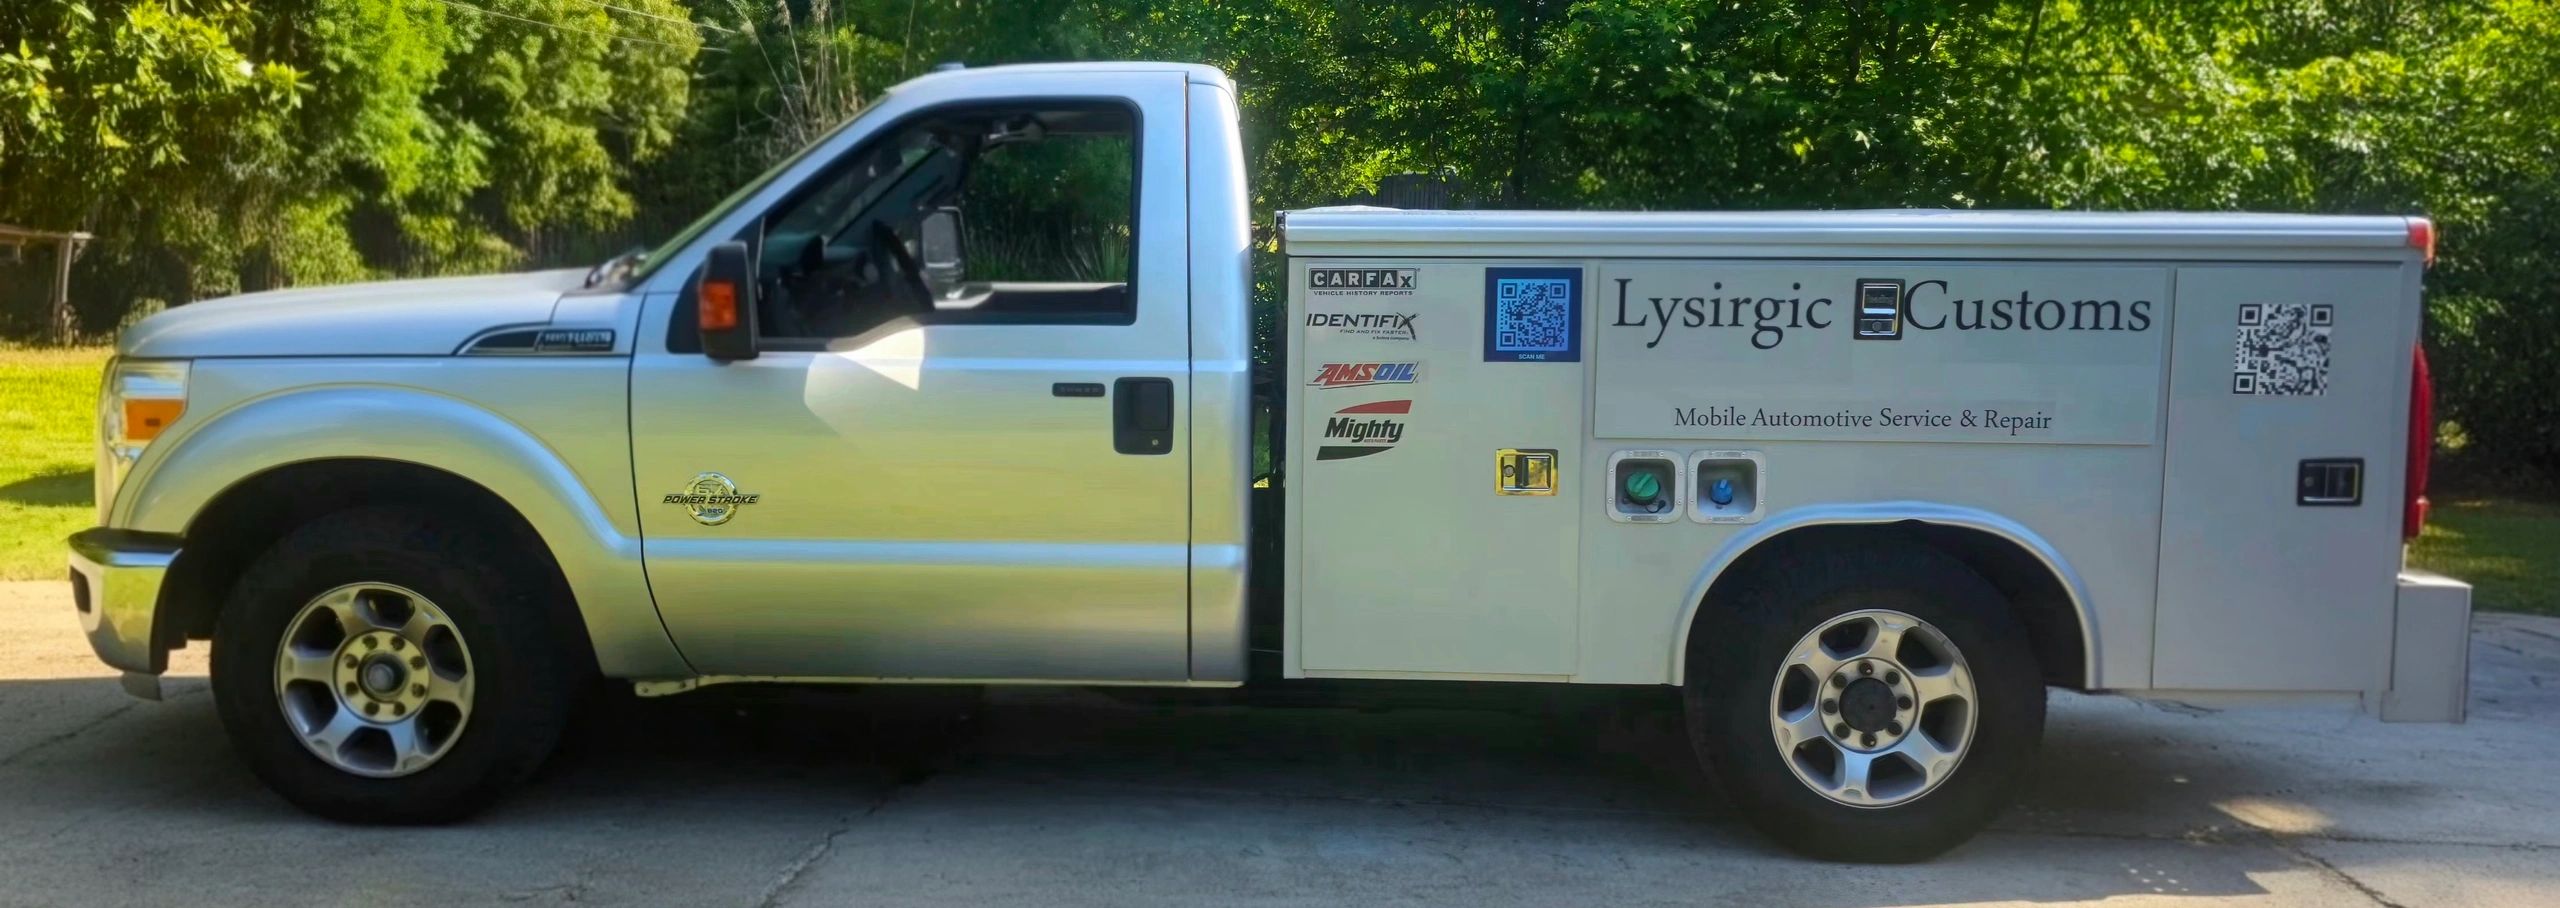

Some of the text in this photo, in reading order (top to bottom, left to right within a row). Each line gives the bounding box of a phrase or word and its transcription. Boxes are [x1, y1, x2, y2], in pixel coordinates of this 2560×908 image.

[1311, 270, 1414, 288] CARFAX
[1306, 312, 1418, 341] IDENTIFIX
[1612, 278, 2152, 350] Lysirgic Customs
[1311, 362, 1417, 387] AMSOIL
[1324, 417, 1405, 444] Mighty
[1674, 406, 2053, 437] Mobile Automotive Service & Repair
[663, 495, 758, 504] POWER STROKE
